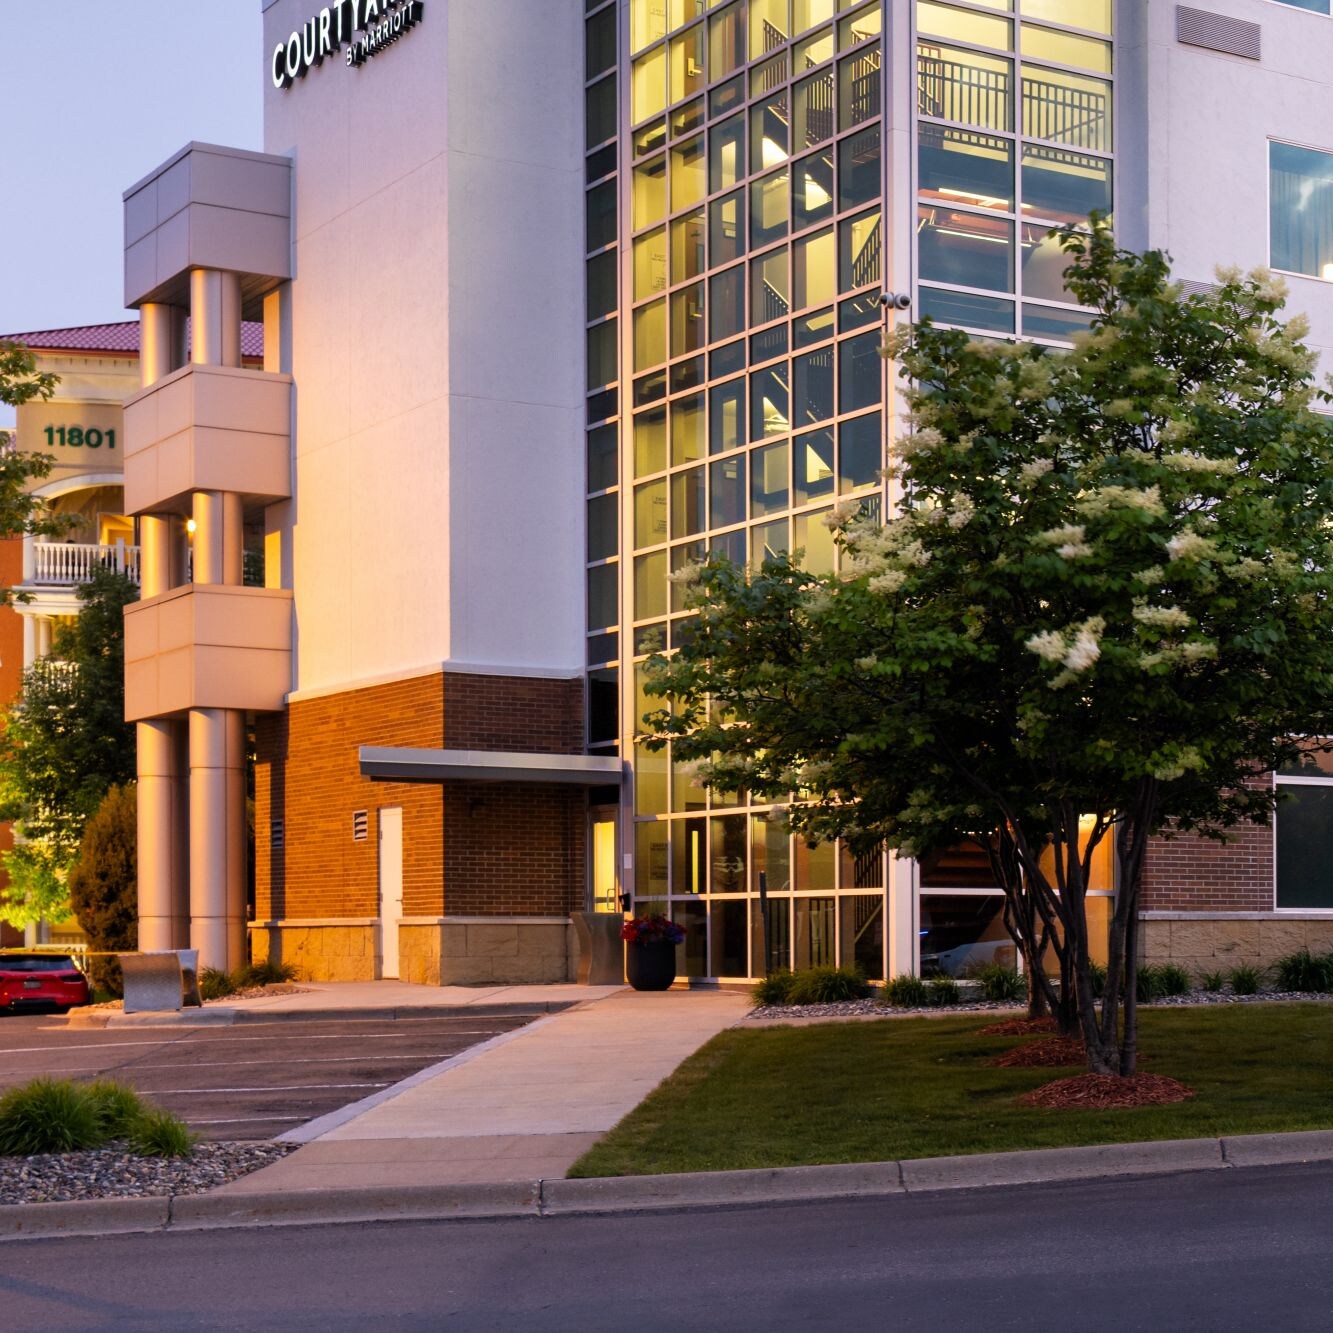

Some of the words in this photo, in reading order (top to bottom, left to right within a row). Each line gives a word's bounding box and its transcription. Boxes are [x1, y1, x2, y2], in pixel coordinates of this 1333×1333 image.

[272, 0, 396, 88] COURTYA
[346, 43, 358, 66] BY
[361, 1, 414, 56] MARRIOTT
[44, 426, 115, 449] 11801
